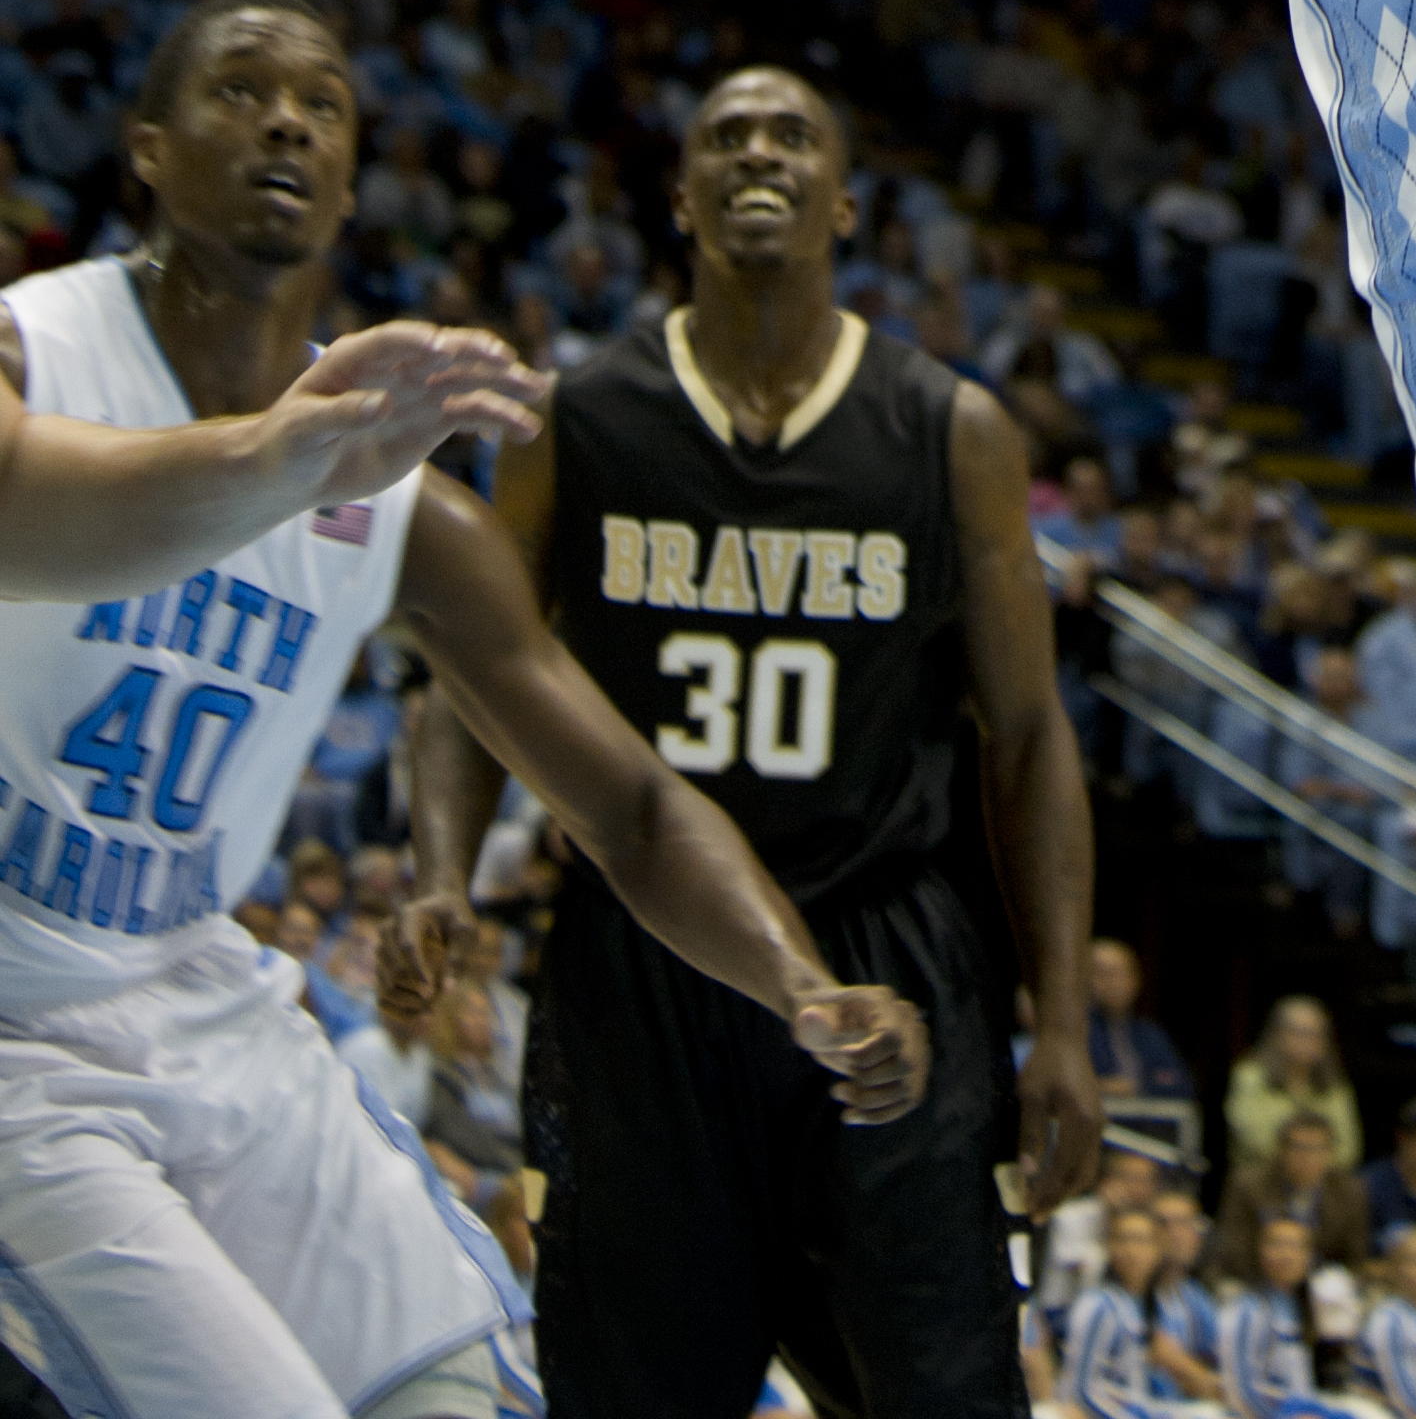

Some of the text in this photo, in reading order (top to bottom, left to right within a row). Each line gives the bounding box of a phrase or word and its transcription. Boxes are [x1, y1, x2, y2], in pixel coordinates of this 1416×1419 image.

[602, 514, 908, 622] BRAVES
[60, 664, 256, 832] 40
[656, 632, 837, 781] 30
